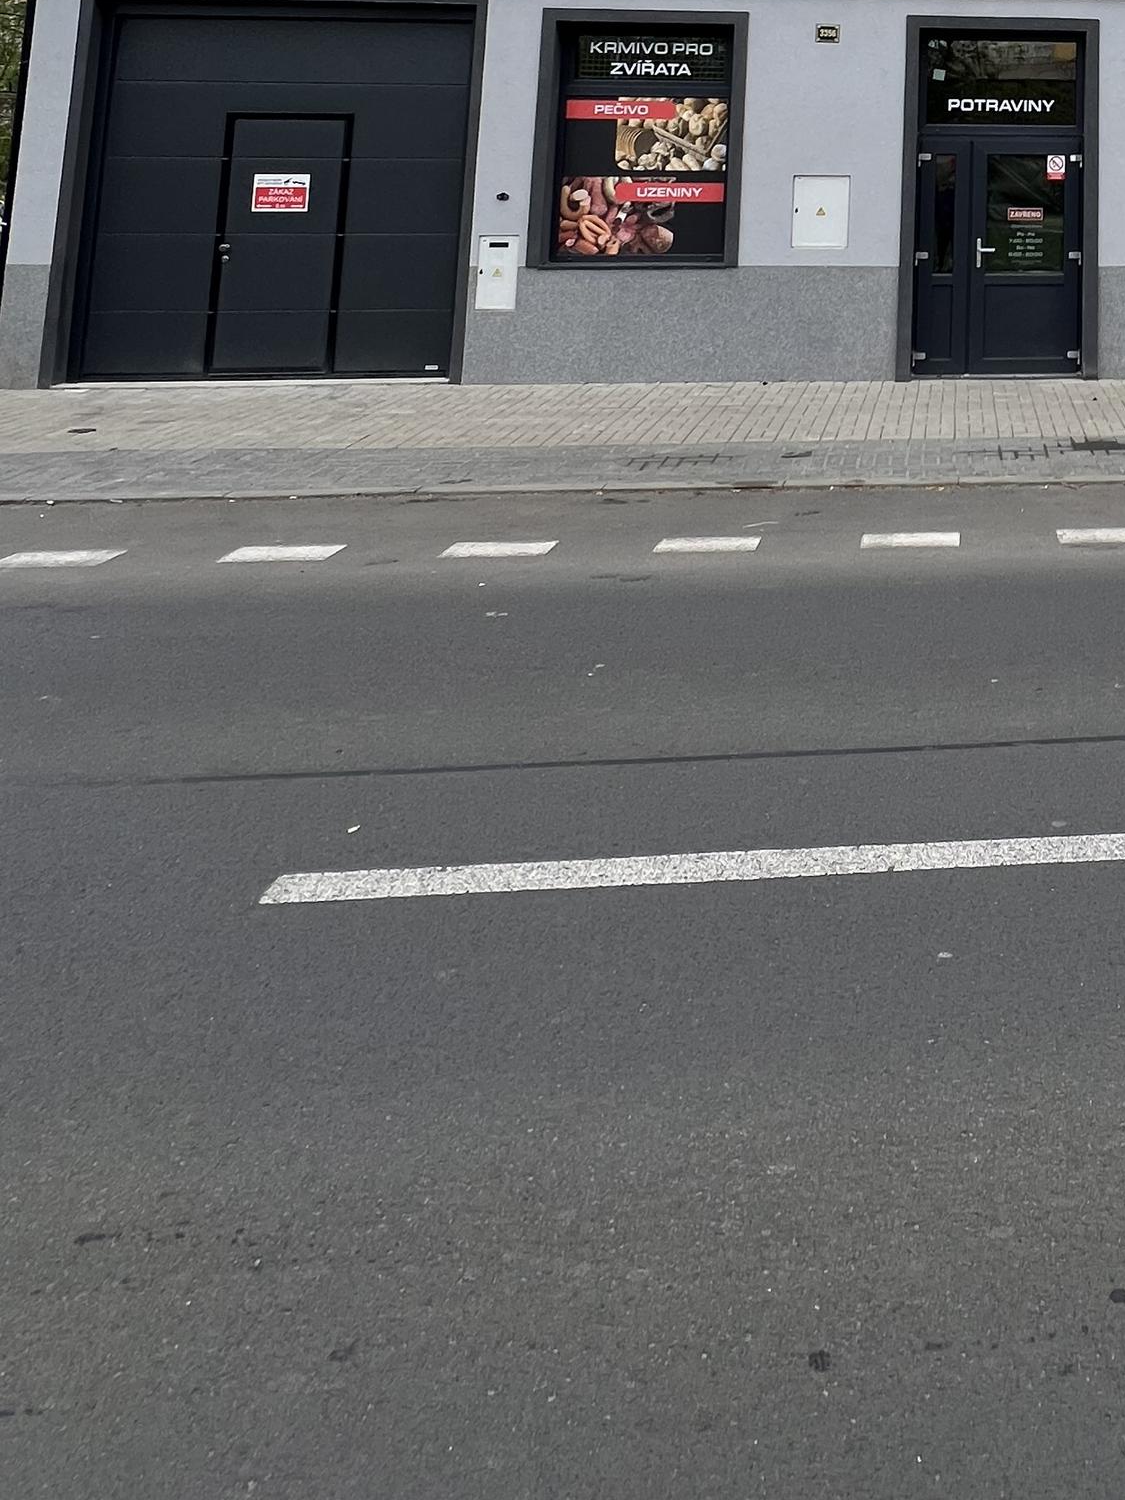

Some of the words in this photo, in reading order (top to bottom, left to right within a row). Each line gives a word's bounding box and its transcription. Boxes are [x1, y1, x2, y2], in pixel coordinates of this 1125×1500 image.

[590, 41, 669, 55] KRMIVO
[672, 43, 713, 56] PRO
[610, 60, 692, 76] ZVÍŘATA
[594, 102, 649, 115] PEČIVO
[948, 98, 1055, 113] POTRAVINY
[636, 186, 704, 198] UZENINY
